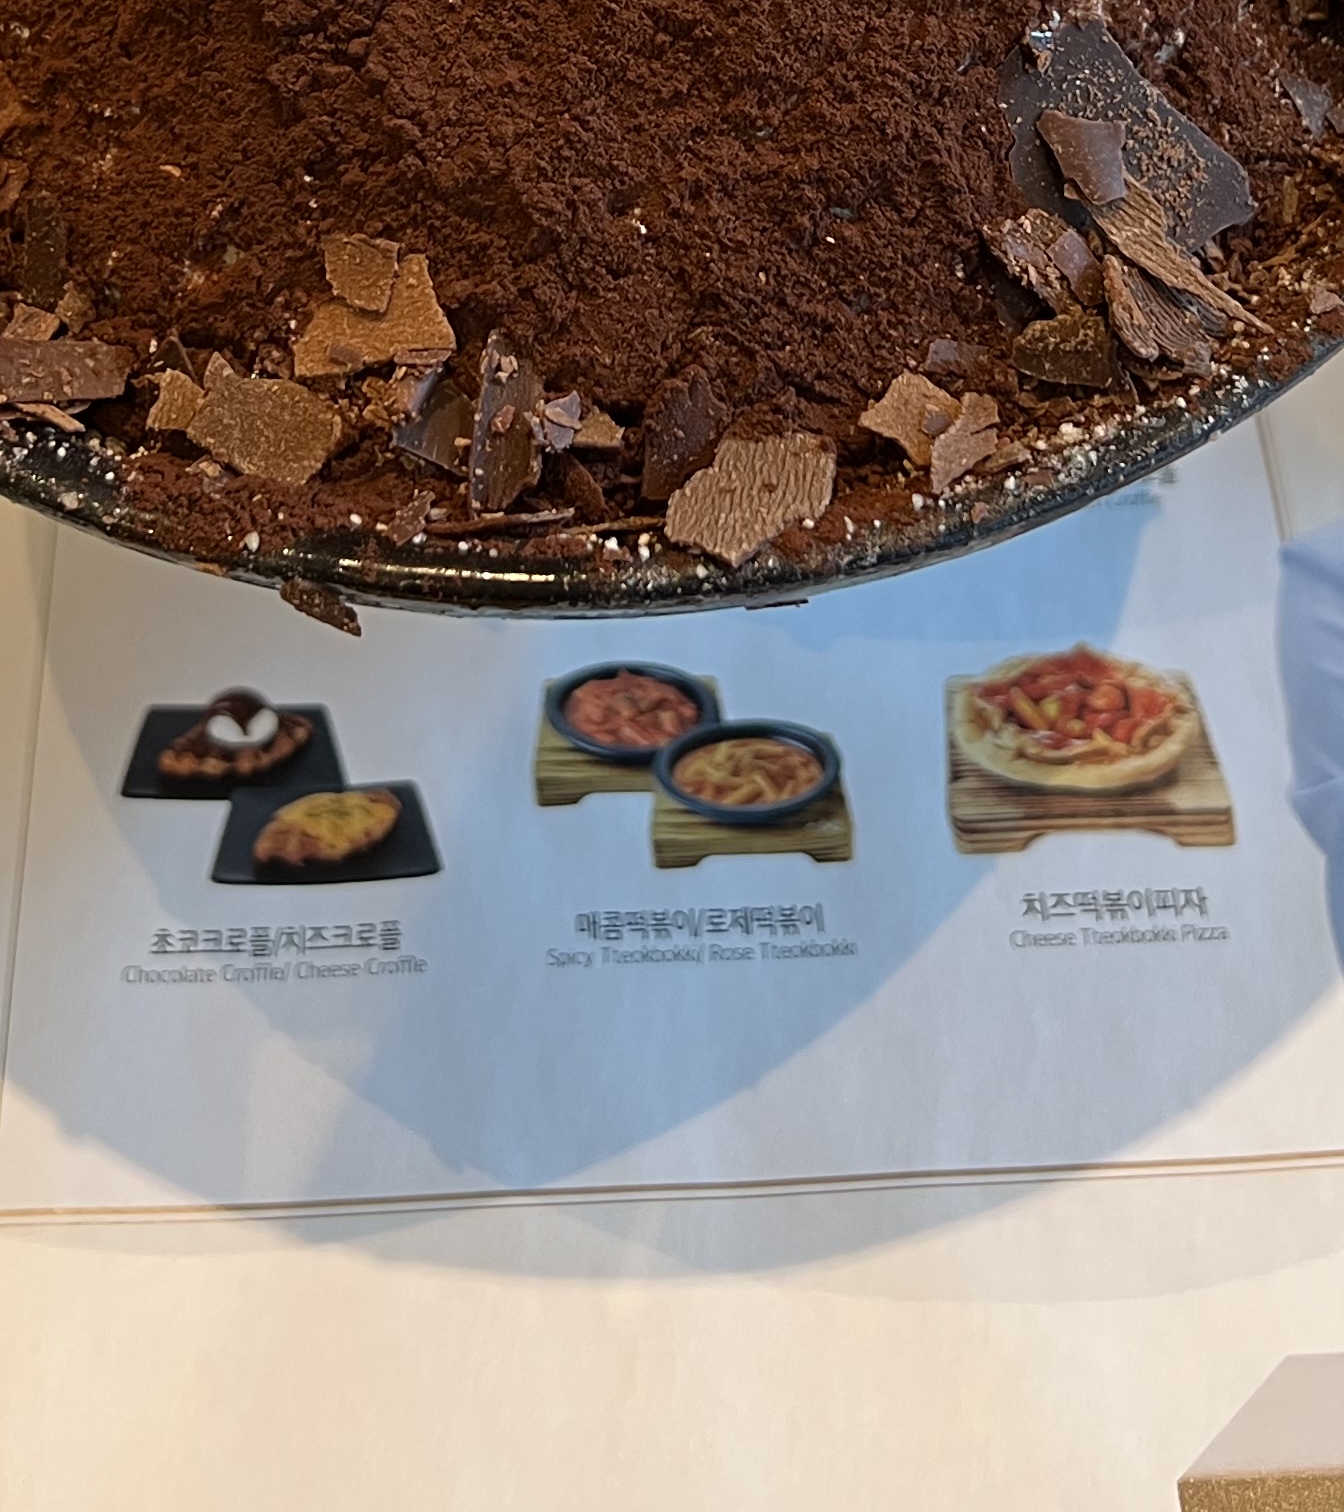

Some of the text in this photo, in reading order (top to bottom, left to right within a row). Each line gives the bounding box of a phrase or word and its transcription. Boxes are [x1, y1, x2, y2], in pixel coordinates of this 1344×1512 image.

[1022, 886, 1209, 922] 치즈떡볶이피자
[149, 920, 402, 957] 초코크로플/치즈크로플
[122, 964, 217, 984] Chocolate
